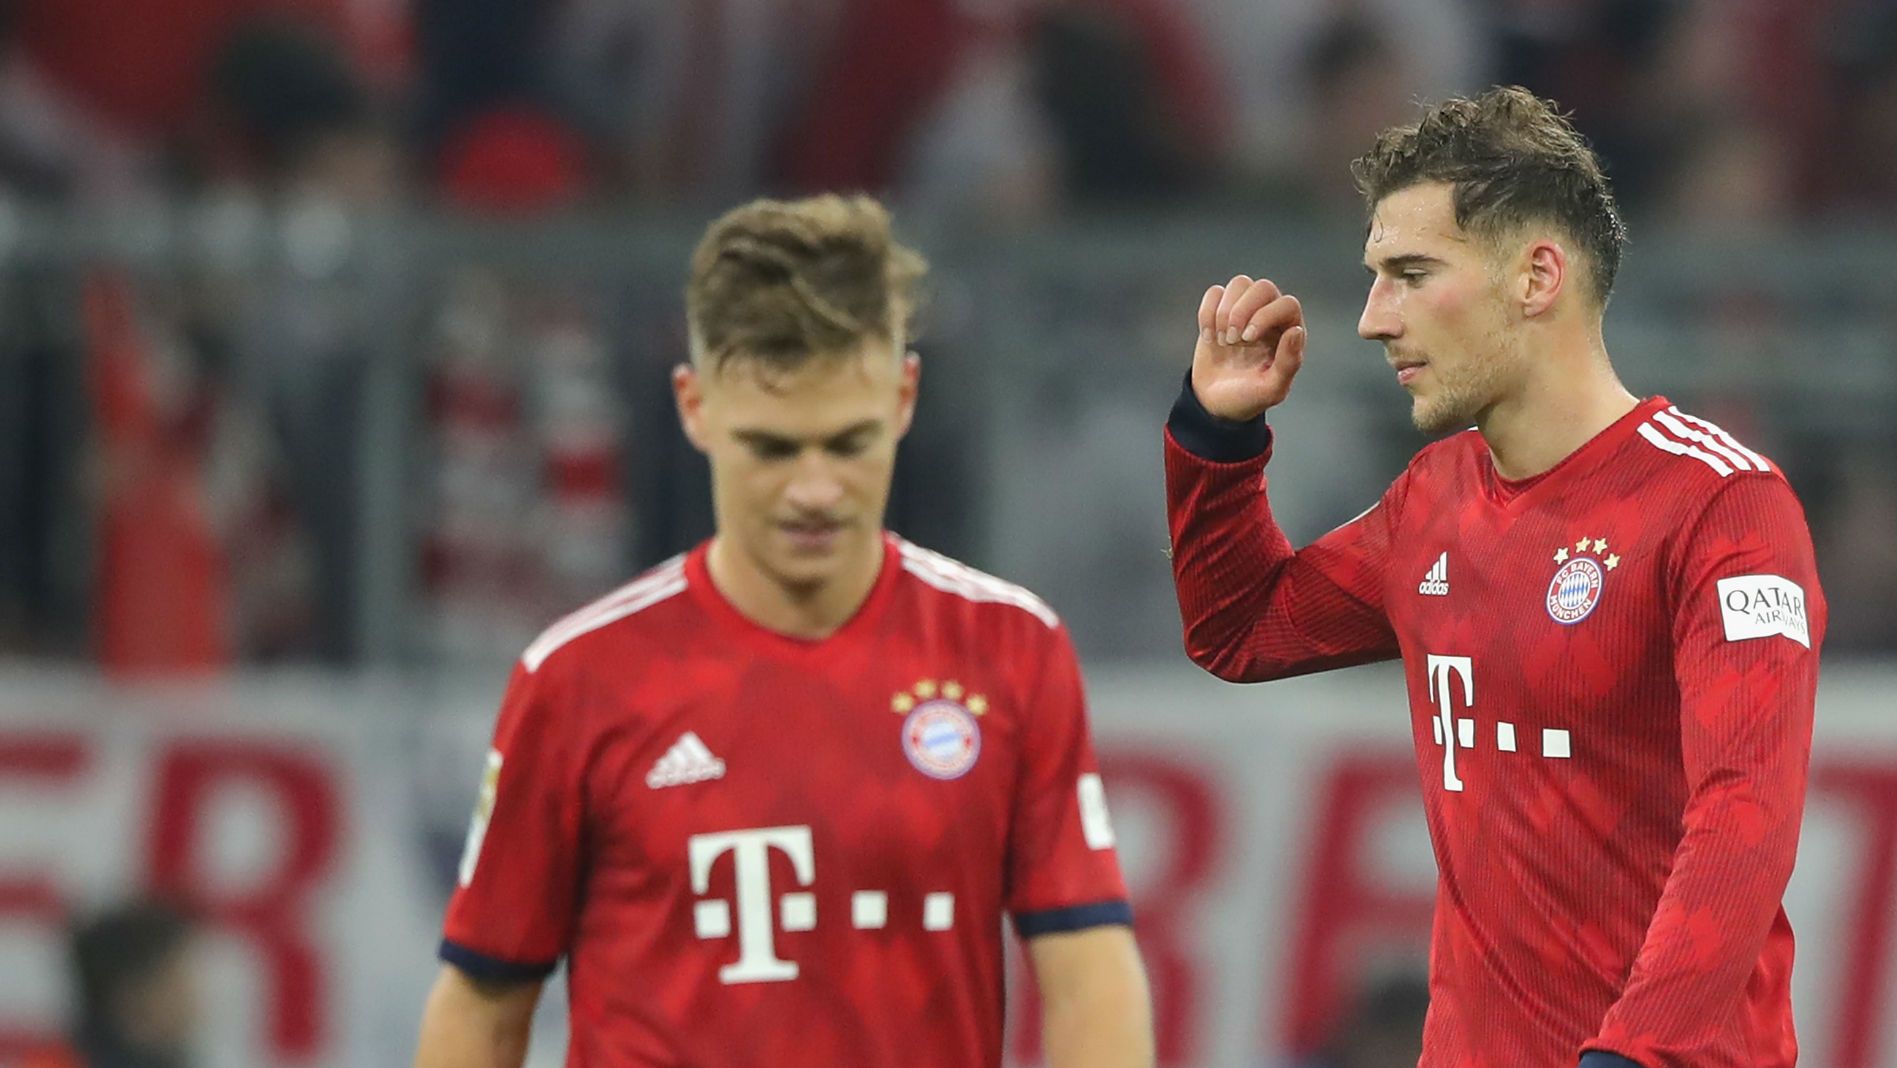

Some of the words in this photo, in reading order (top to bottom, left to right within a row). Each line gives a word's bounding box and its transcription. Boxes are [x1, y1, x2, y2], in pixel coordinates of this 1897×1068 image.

[1418, 579, 1450, 597] adidas
[1571, 562, 1598, 588] BAYERN
[1725, 586, 1804, 620] QATAR
